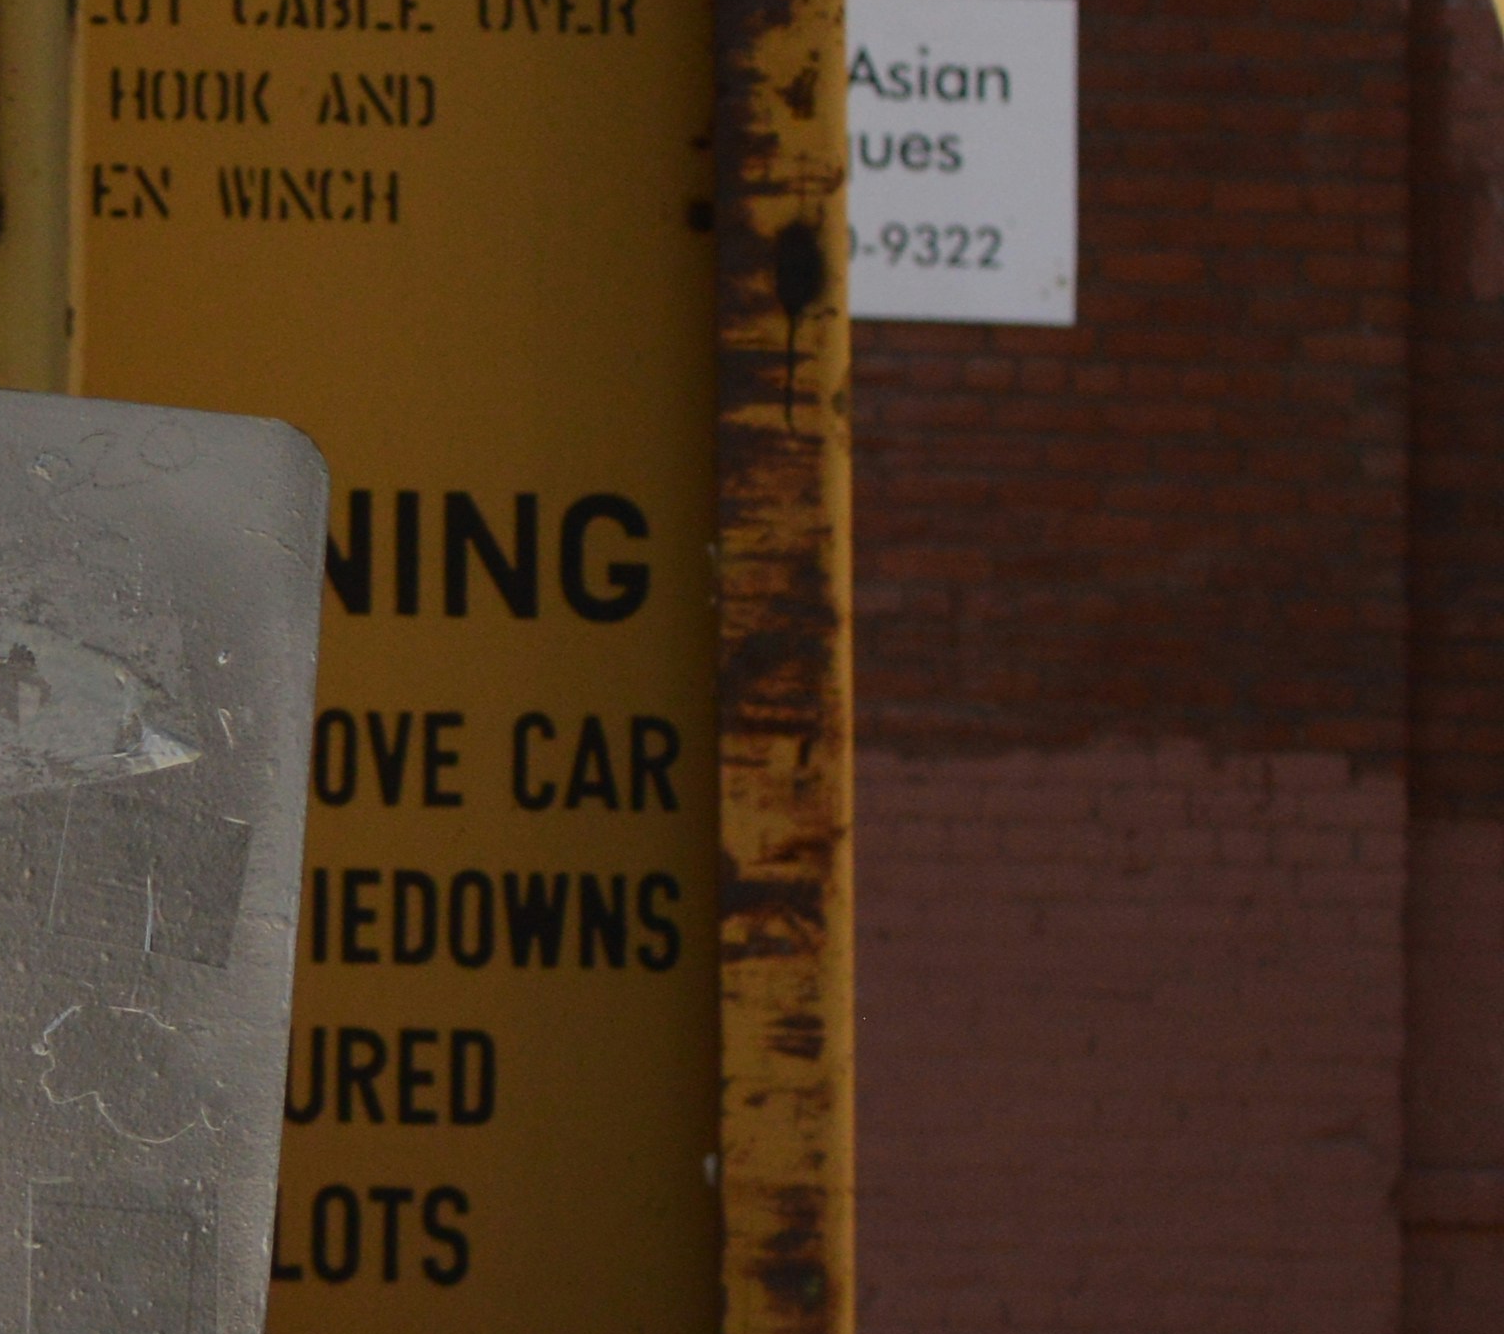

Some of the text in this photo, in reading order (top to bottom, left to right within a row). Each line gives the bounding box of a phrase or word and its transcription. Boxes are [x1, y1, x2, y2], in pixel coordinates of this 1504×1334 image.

[110, 68, 436, 128] HOOK AND
[849, 43, 1014, 105] Asian
[846, 127, 966, 173] ues
[218, 166, 399, 224] WINCH
[312, 705, 684, 814] OVE CAR
